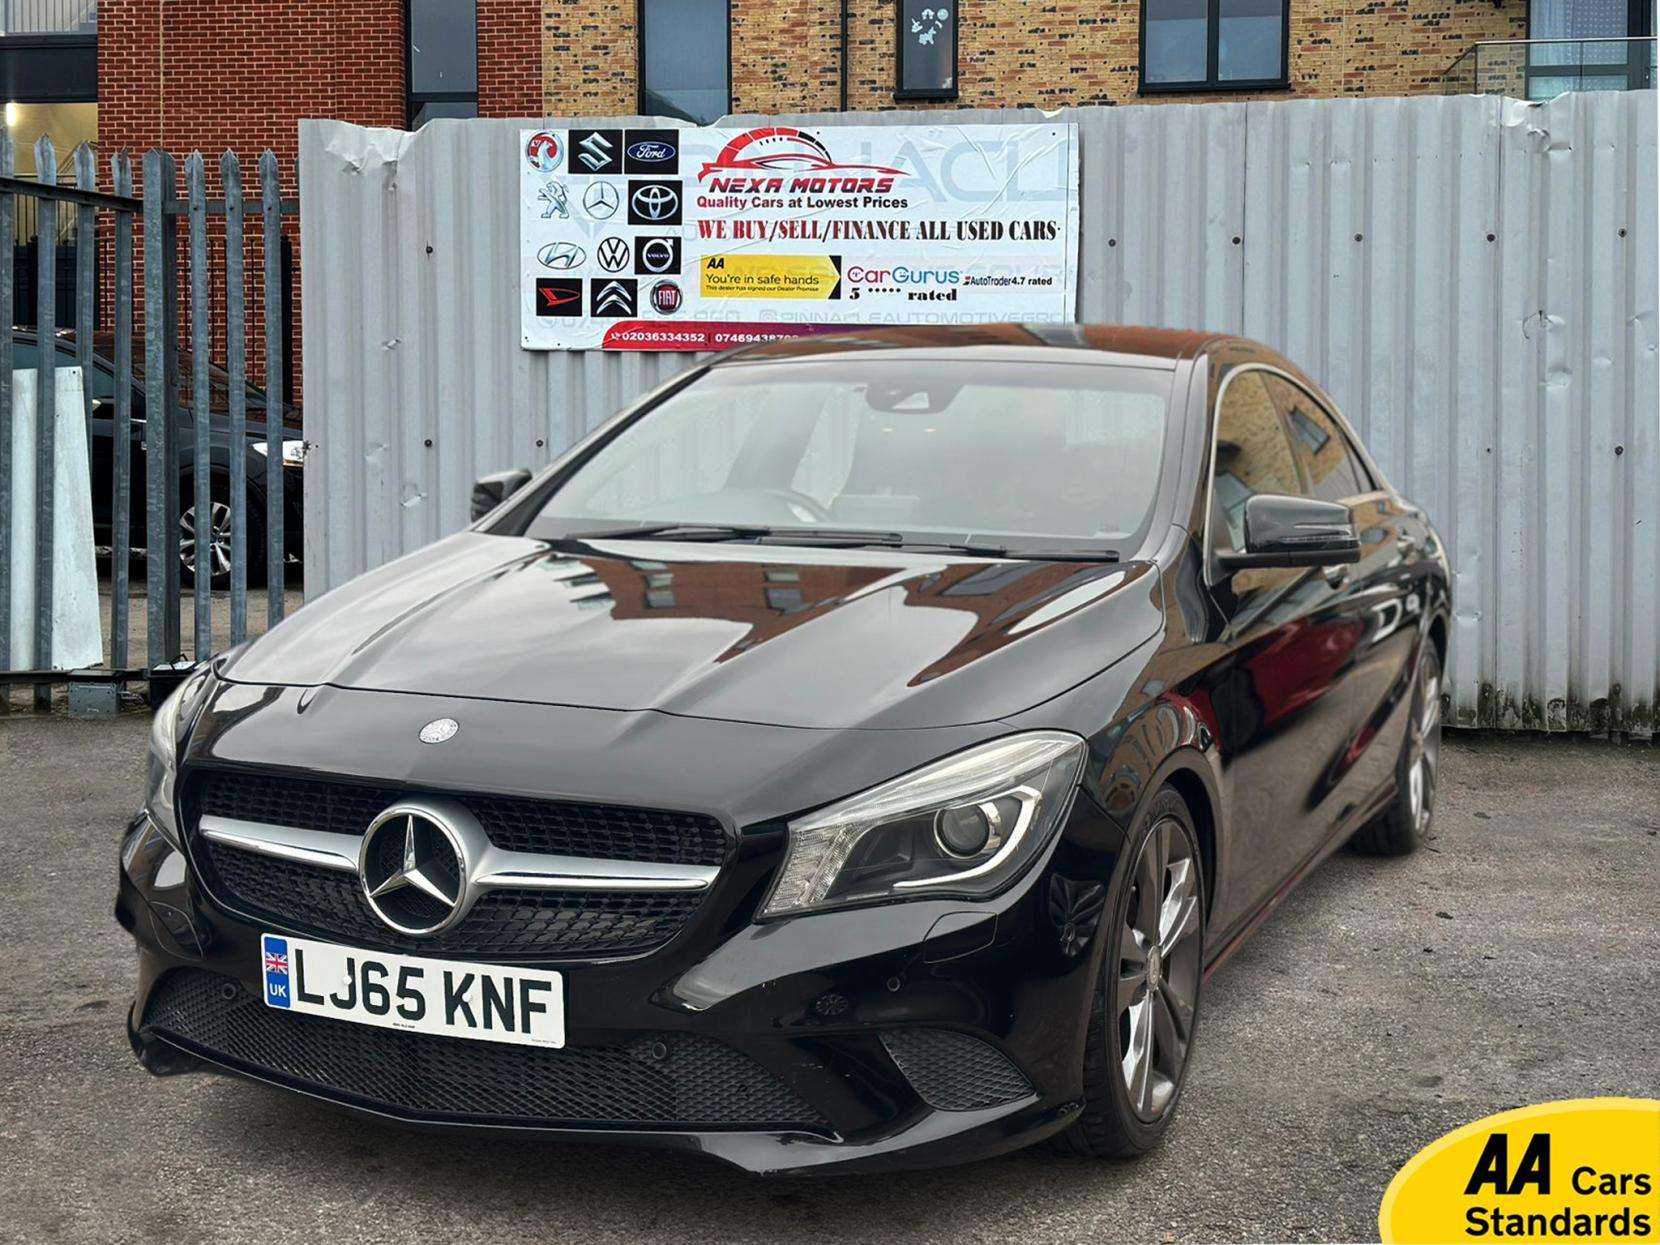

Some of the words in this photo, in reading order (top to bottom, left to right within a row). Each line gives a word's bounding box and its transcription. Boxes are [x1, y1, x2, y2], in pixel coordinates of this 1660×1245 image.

[636, 144, 666, 159] Ford
[709, 178, 784, 193] NEXA
[789, 178, 894, 193] MOTORS
[697, 196, 747, 211] Quality
[752, 197, 784, 209] Cars
[788, 197, 803, 209] at
[808, 197, 858, 209] Lowest
[863, 197, 908, 209] Prices
[698, 220, 726, 239] WE
[733, 220, 911, 242] BUY/SELL/FINANCE
[916, 220, 951, 240] ALL
[956, 220, 1004, 240] USED
[1009, 220, 1057, 240] CARS
[707, 258, 725, 269] AA
[706, 274, 741, 284] You're
[744, 274, 754, 284] in
[757, 274, 781, 284] safe
[784, 275, 819, 285] hands
[847, 266, 960, 284] CarGurus
[1028, 277, 1053, 285] rated
[658, 290, 676, 306] FIAT
[850, 287, 860, 300] 5
[908, 288, 957, 301] rated
[622, 332, 705, 342] 02036334352
[269, 984, 287, 998] UK
[294, 949, 426, 1021] LJ65
[443, 971, 552, 1034] KNF
